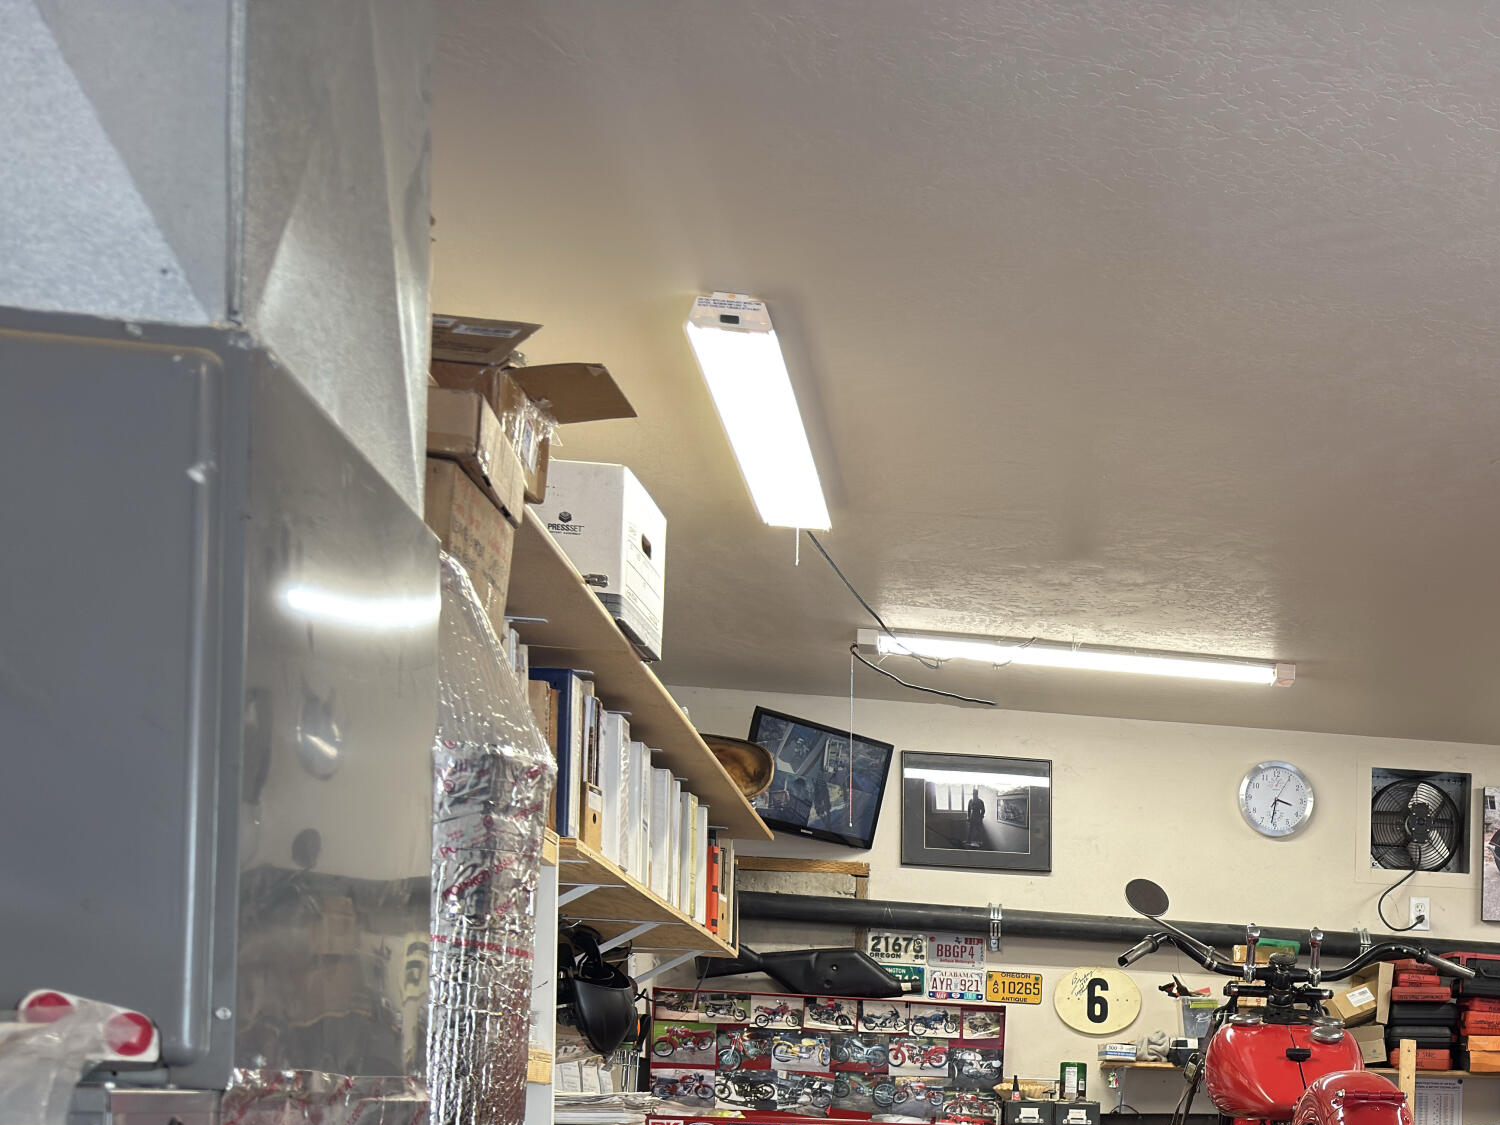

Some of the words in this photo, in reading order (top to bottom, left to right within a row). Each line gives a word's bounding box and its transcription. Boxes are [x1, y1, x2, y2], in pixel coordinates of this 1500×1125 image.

[939, 971, 973, 979] ALABAMA
[931, 977, 951, 991] AYR
[959, 979, 981, 992] 921
[1001, 981, 1040, 995] 10265
[1087, 978, 1108, 1023] 6
